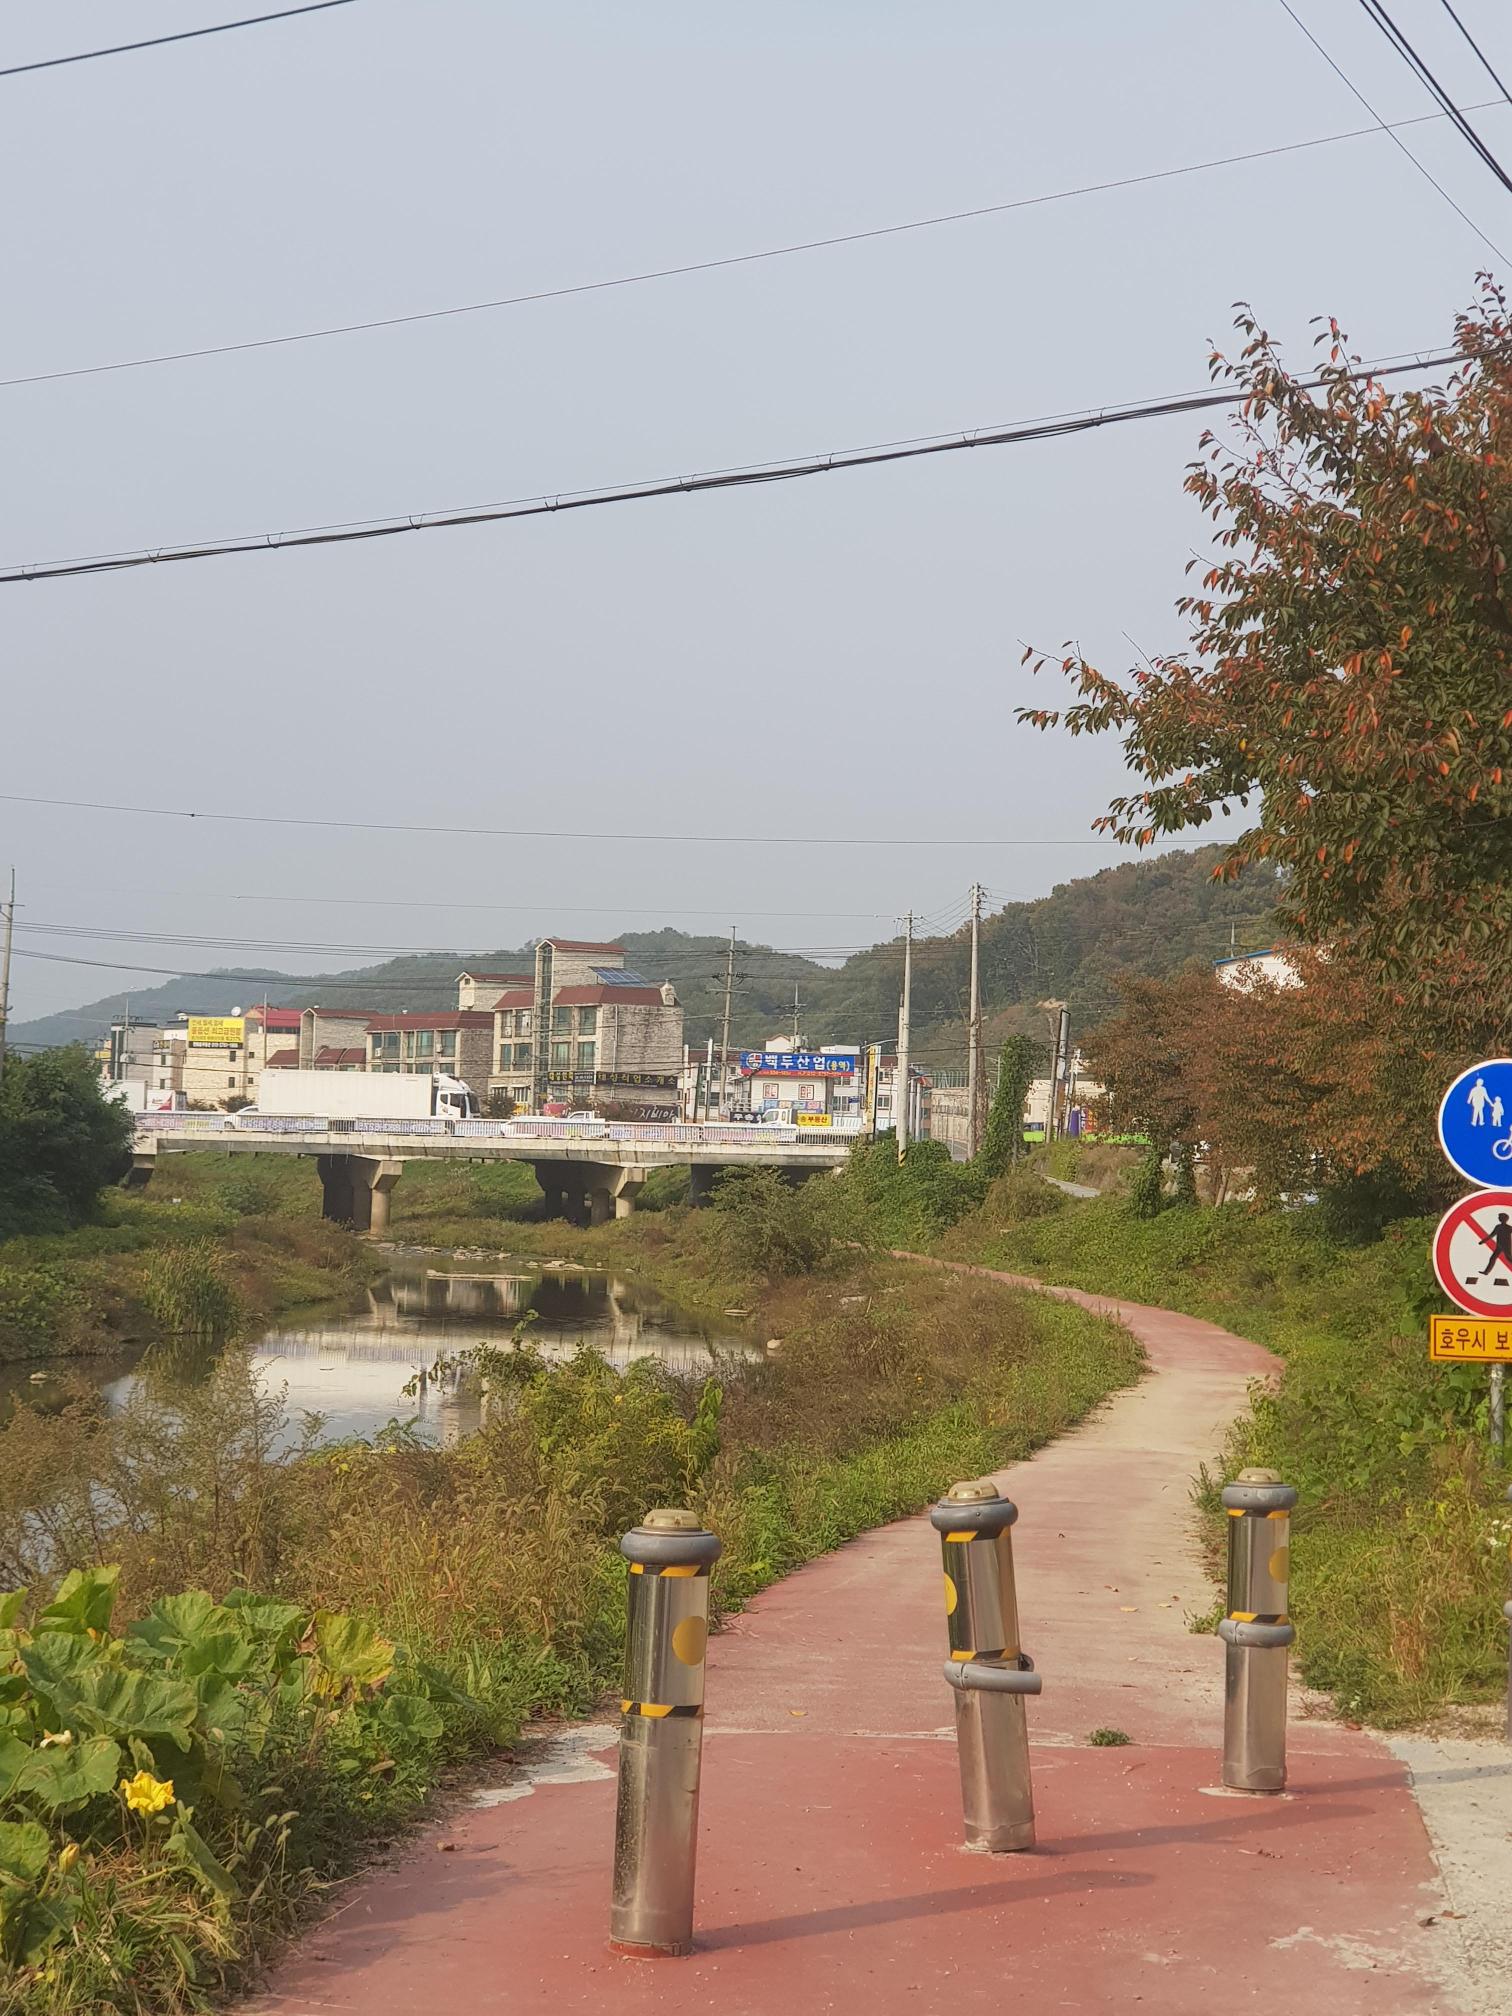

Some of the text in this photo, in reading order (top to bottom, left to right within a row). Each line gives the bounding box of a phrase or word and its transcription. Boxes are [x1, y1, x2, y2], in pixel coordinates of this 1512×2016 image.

[764, 1054, 825, 1071] 백두산업
[1439, 1328, 1512, 1352] 호우시 보
